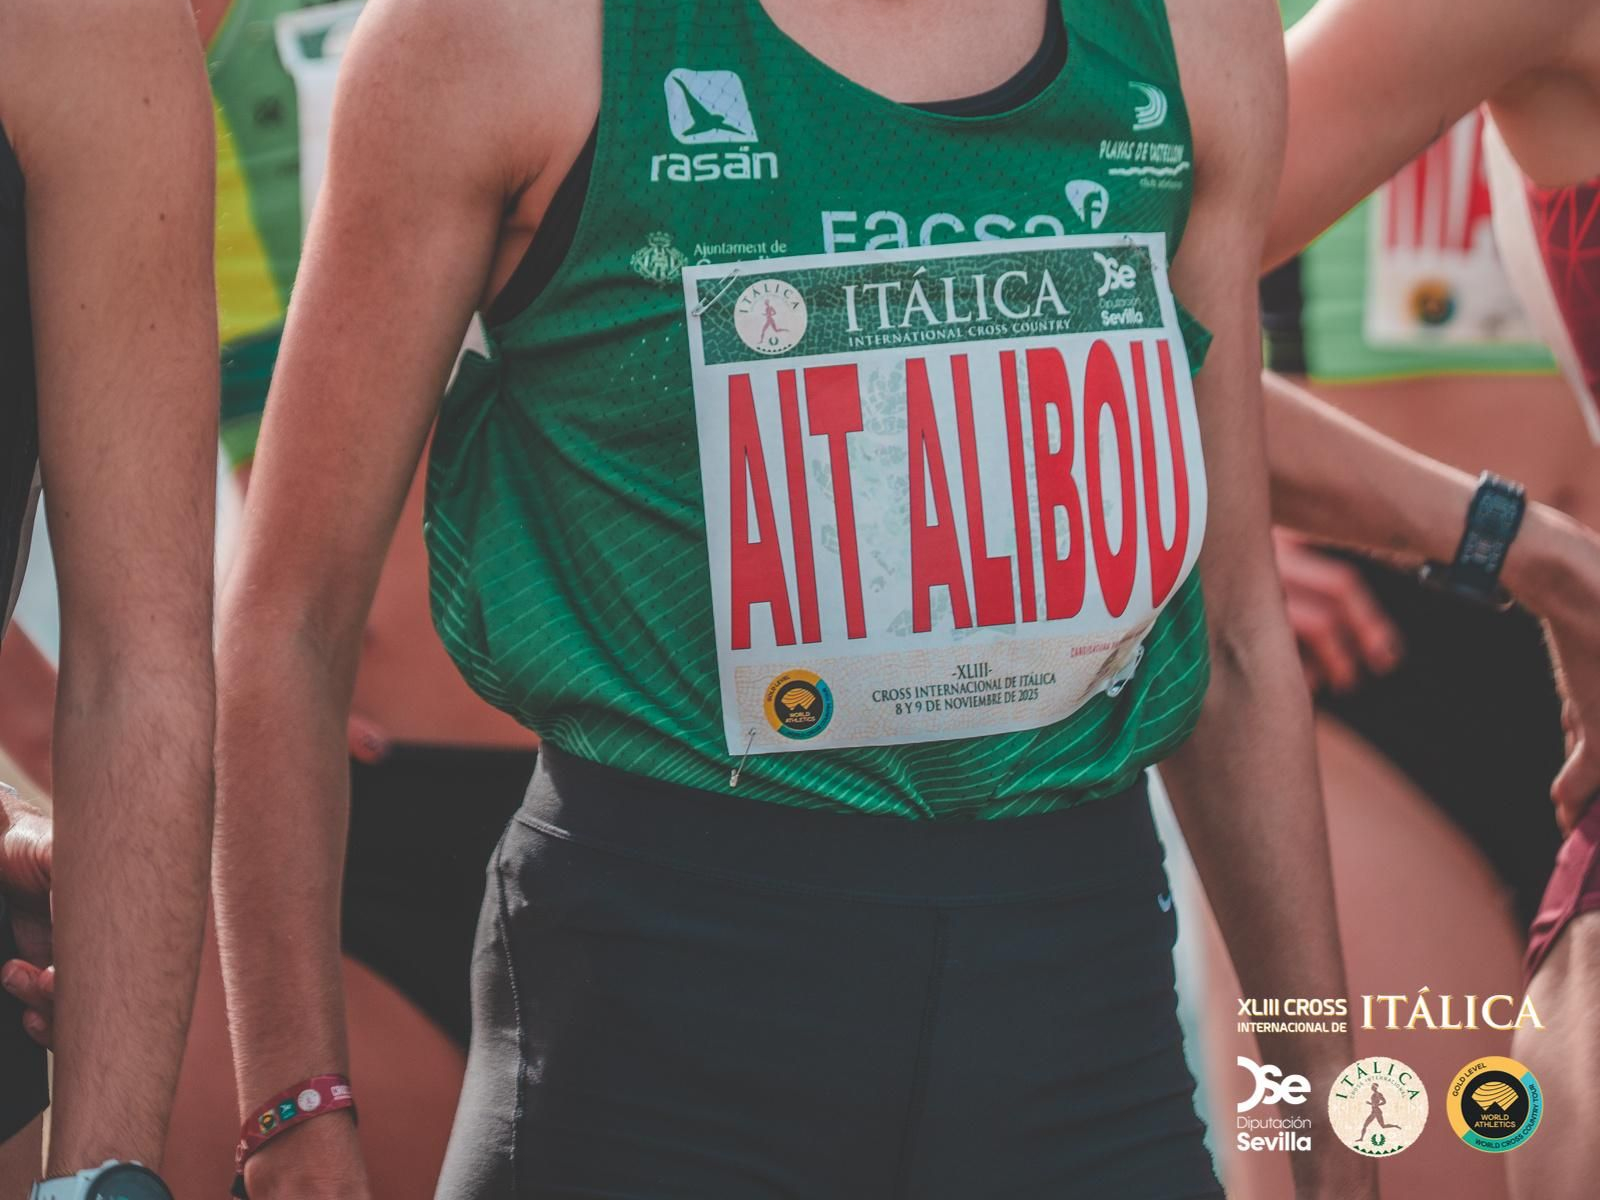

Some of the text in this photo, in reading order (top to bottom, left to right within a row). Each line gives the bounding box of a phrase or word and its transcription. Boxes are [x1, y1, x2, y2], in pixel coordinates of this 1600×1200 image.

[693, 239, 787, 258] Ajuntament de
[842, 265, 1070, 333] ITÁLICA
[1101, 308, 1143, 326] Sevilla
[848, 318, 1071, 348] INTERNATIONAL CROSS COUNTRY
[727, 338, 1191, 651] AIT ALIBOU
[872, 671, 1057, 703] CROSS INTERNACIONAL DE ITÁLICA
[895, 703, 903, 716] 8
[905, 702, 914, 714] Y
[914, 701, 923, 713] 9
[926, 698, 942, 712] DE
[944, 692, 1002, 710] NOVIEMBRE
[1003, 690, 1017, 704] DE
